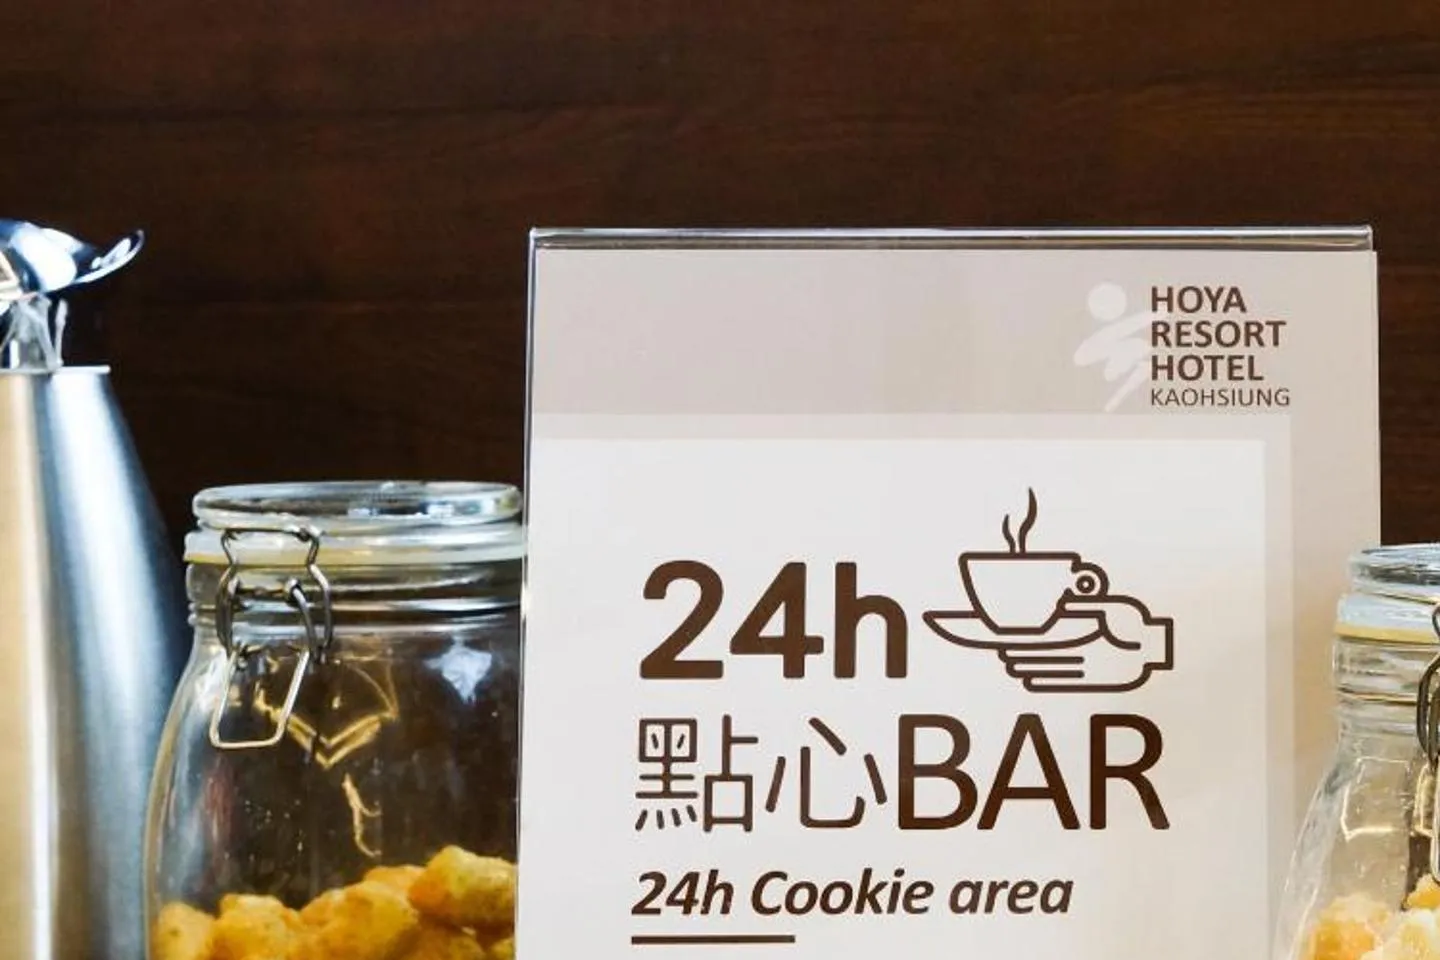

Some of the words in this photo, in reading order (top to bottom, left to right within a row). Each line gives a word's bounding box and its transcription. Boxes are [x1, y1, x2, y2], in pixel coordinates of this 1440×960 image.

[1151, 286, 1247, 313] HOYA
[1151, 320, 1287, 348] RESORT
[1151, 354, 1265, 381] HOTEL
[1151, 388, 1291, 407] KAOHSIUNG
[639, 559, 908, 679] 24h
[631, 869, 734, 915] 24h
[751, 867, 934, 915] Cookie
[949, 878, 1074, 915] area
